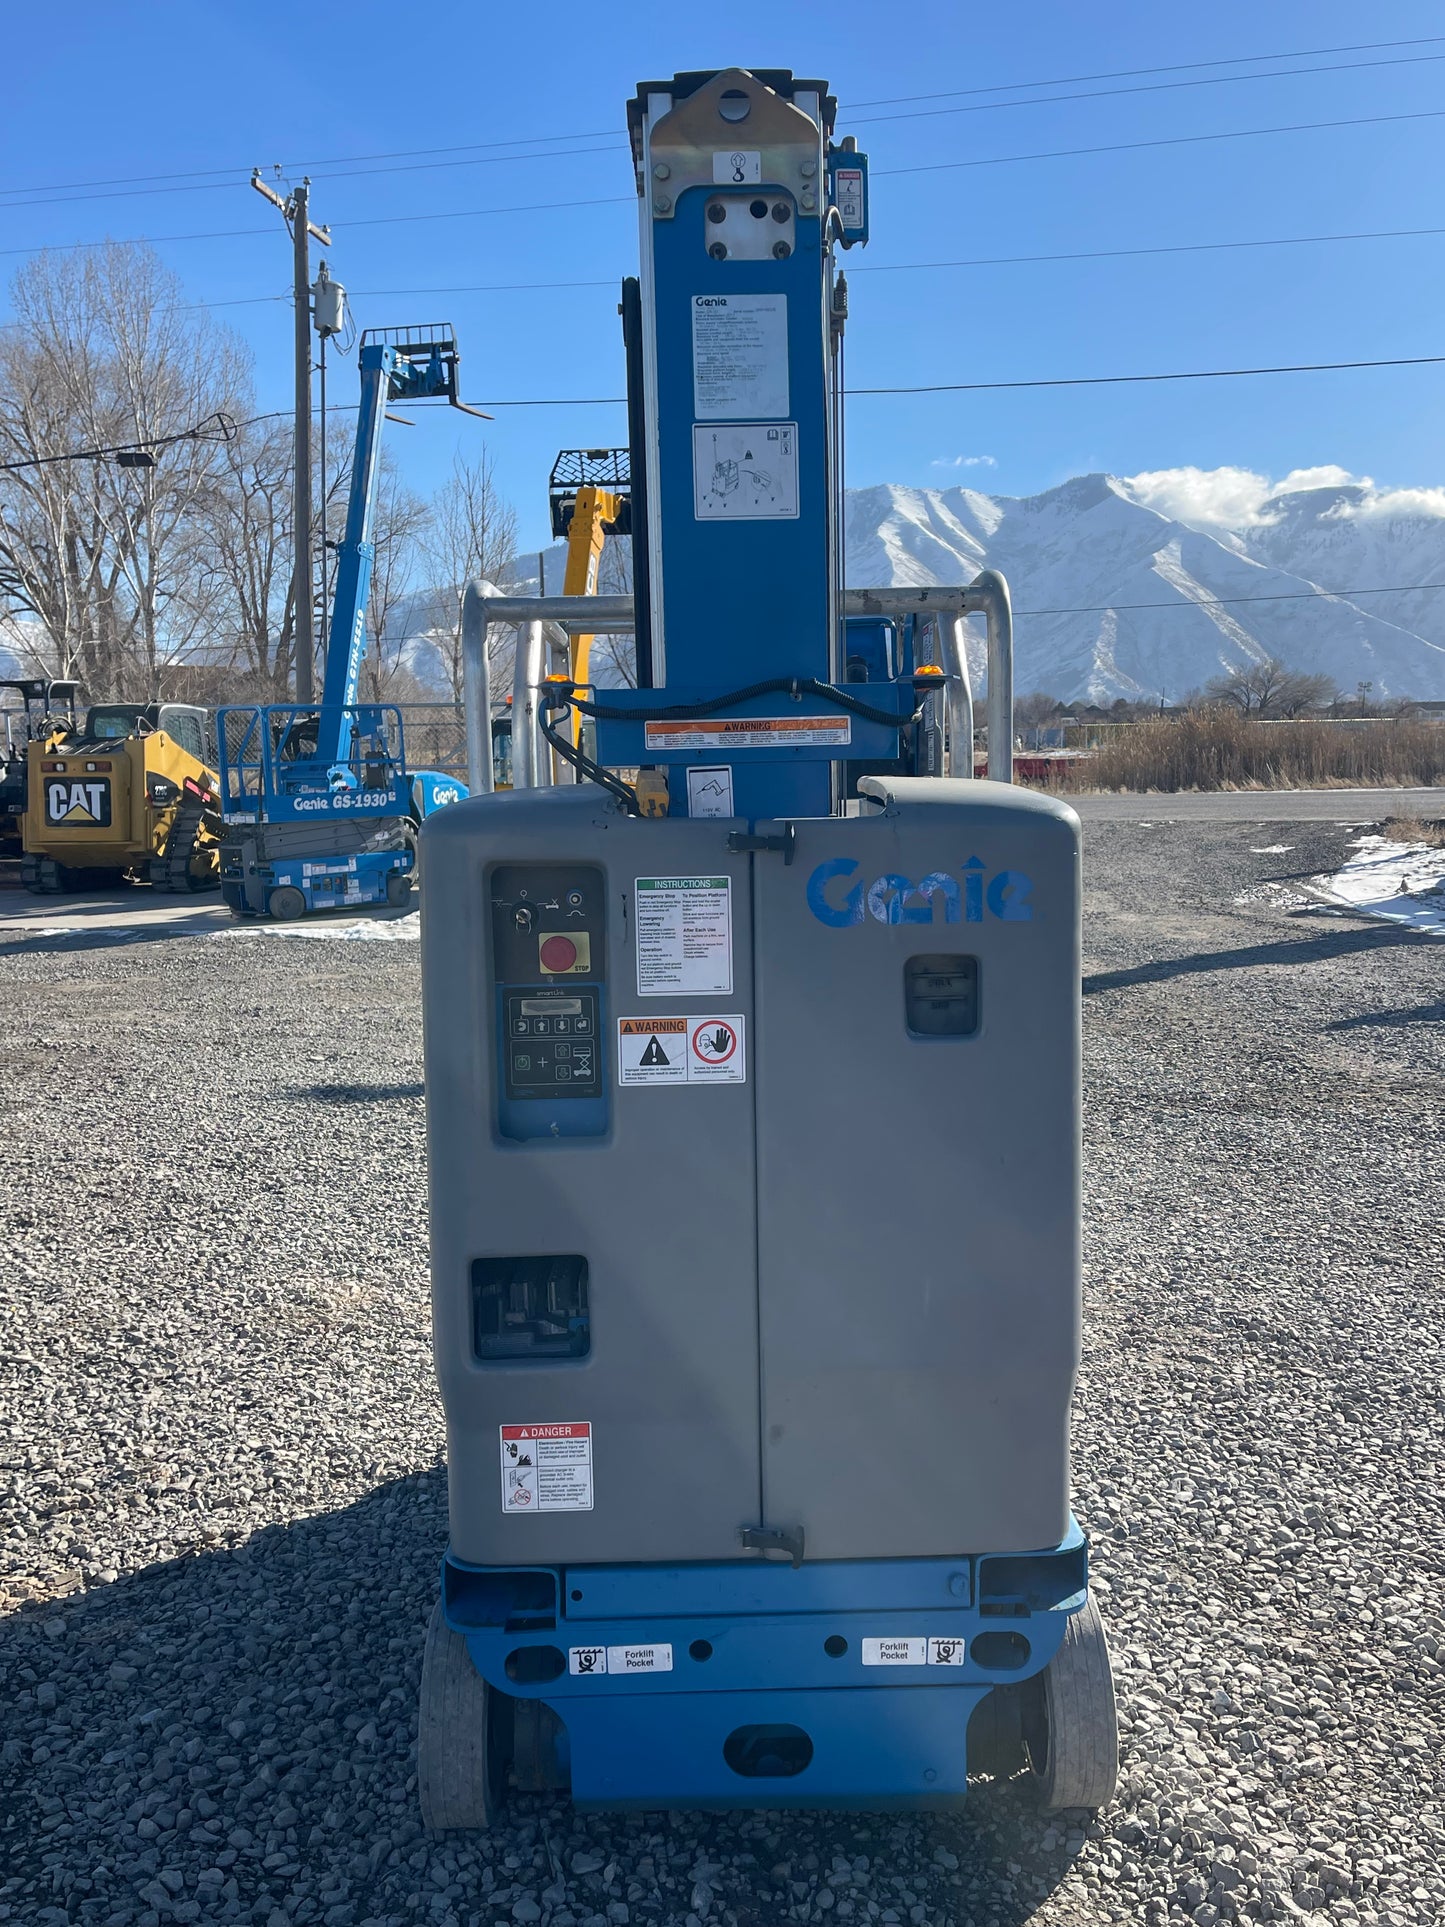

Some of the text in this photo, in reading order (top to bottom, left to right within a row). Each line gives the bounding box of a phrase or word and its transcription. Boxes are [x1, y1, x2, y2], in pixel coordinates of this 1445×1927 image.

[696, 296, 727, 307] Genie
[585, 553, 597, 596] CB
[731, 722, 770, 731] WARNING
[48, 783, 106, 821] CAT
[293, 793, 388, 811] Genie GS-1930
[654, 879, 711, 889] INSTRUCTIONS
[806, 855, 1035, 929] Genie
[635, 1020, 684, 1032] WARNING
[531, 1427, 572, 1437] DANGER
[880, 1642, 908, 1651] Forklift
[625, 1650, 654, 1659] Forklift
[880, 1652, 908, 1660] Pocket
[626, 1659, 654, 1668] Pocket
